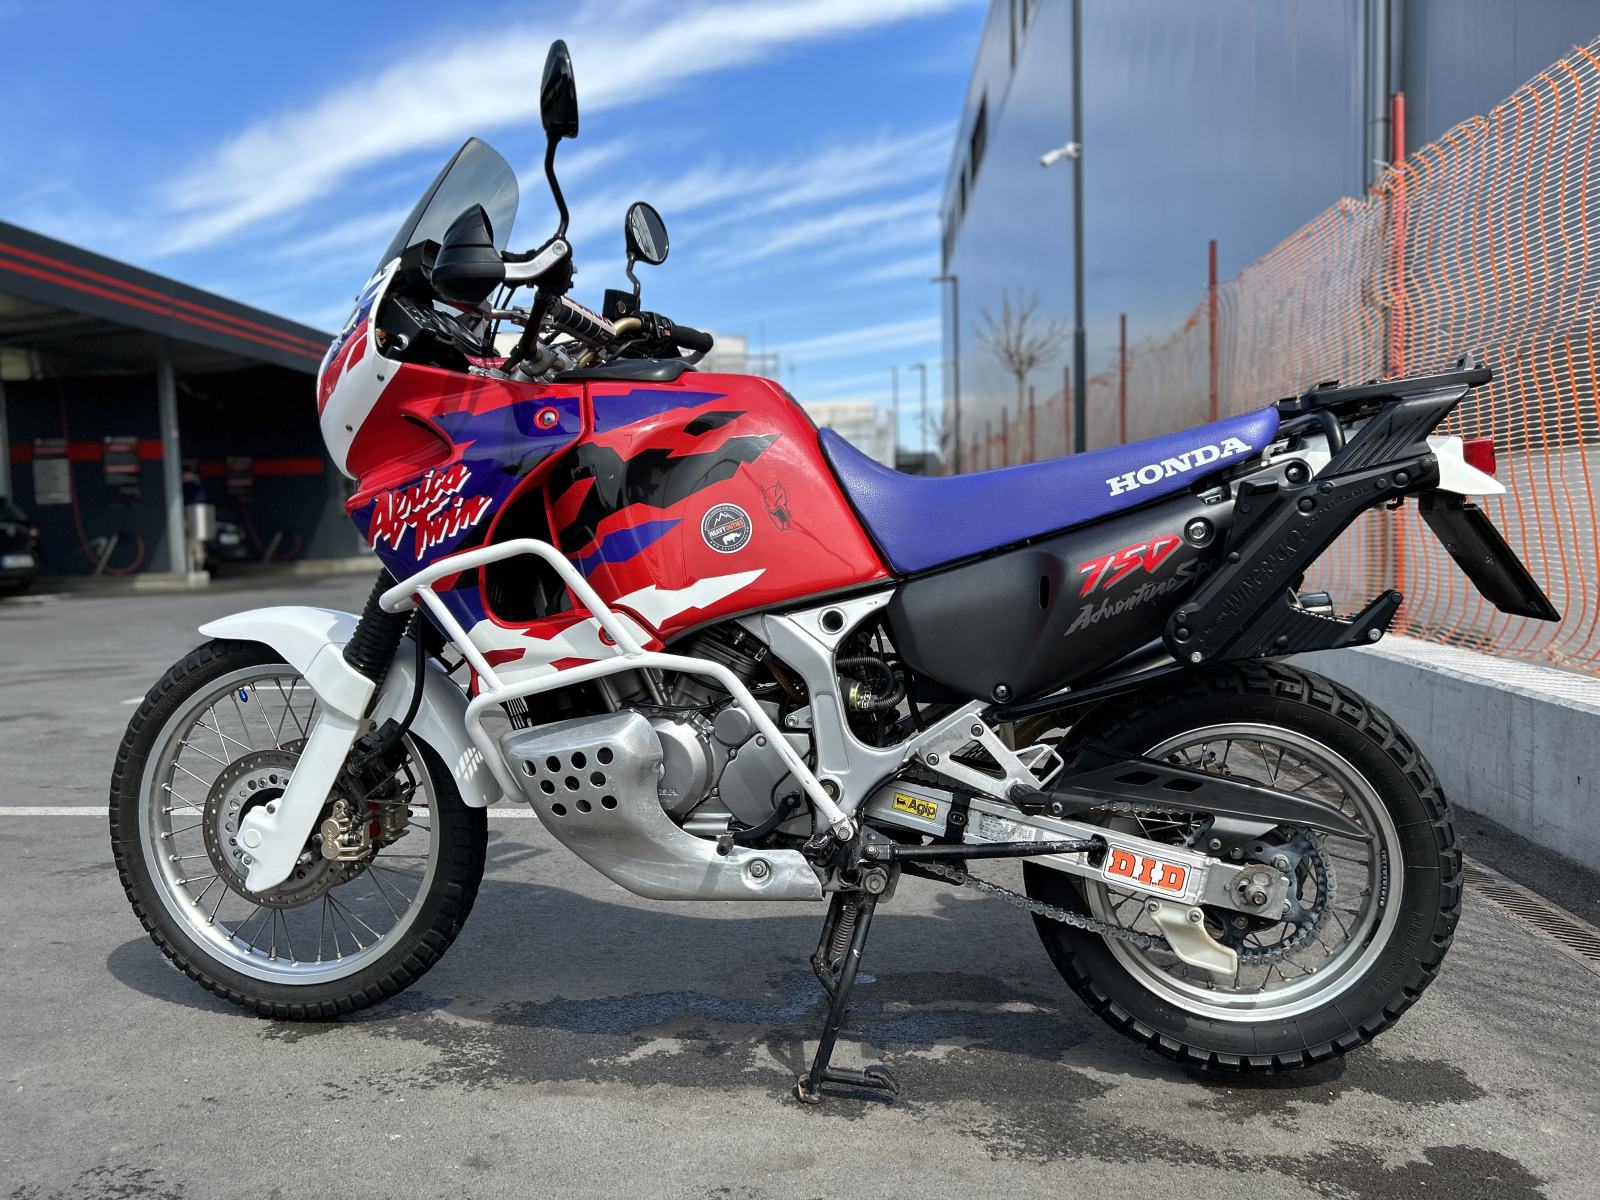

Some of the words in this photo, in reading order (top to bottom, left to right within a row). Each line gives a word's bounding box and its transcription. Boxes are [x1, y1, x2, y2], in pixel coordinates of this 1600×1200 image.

[1106, 437, 1252, 497] HONDA
[368, 464, 472, 551] Africa
[403, 496, 493, 561] Twin
[1077, 533, 1184, 599] 750
[908, 798, 936, 817] Agip
